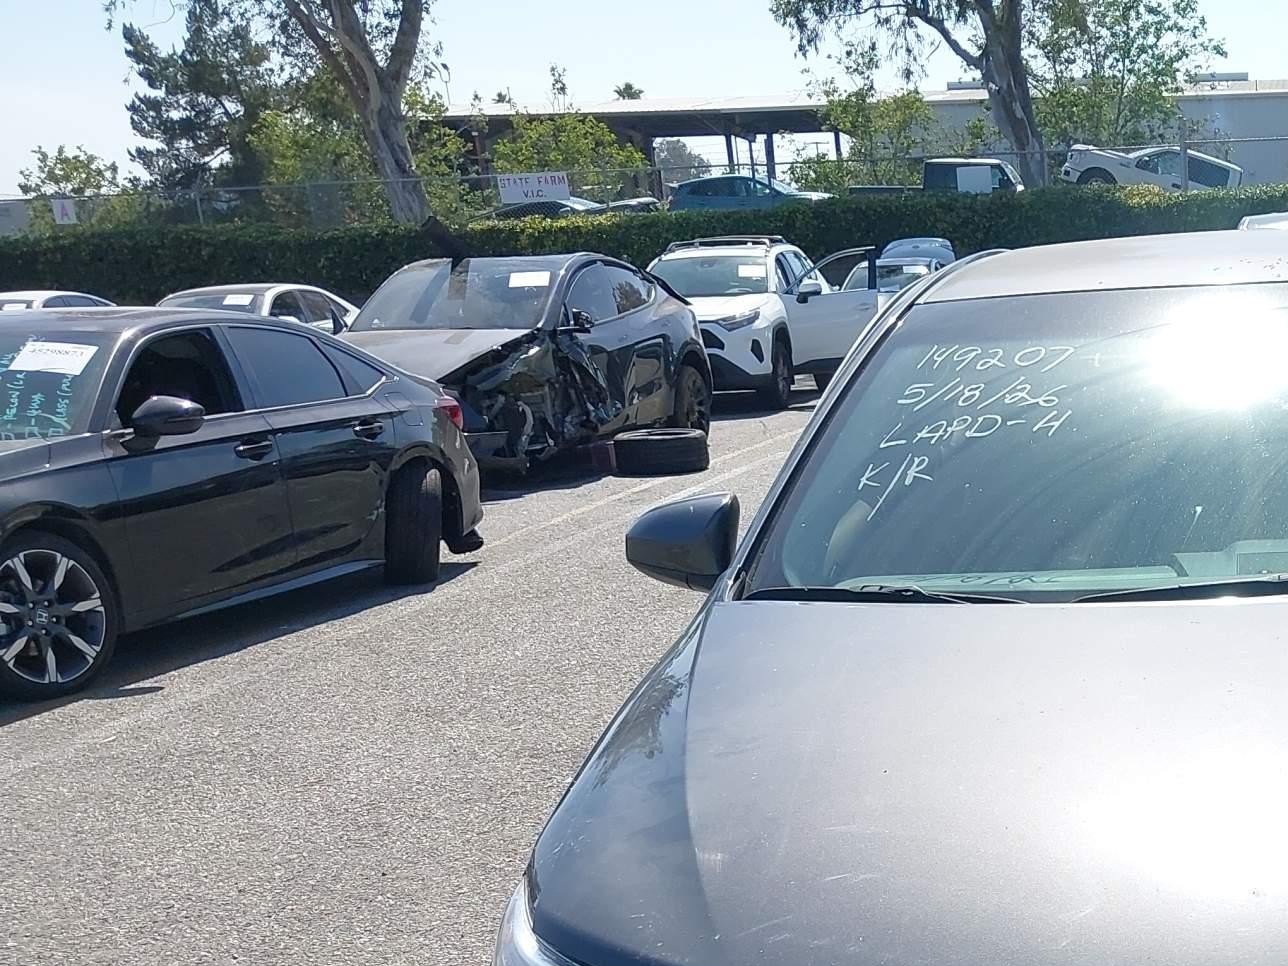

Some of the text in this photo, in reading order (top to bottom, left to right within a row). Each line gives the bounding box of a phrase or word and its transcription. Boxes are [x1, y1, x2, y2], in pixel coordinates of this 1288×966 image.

[500, 175, 566, 188] STATE FARM
[917, 344, 1076, 373] 149207
[897, 376, 1068, 412] 5/18/26
[857, 453, 934, 521] K/R
